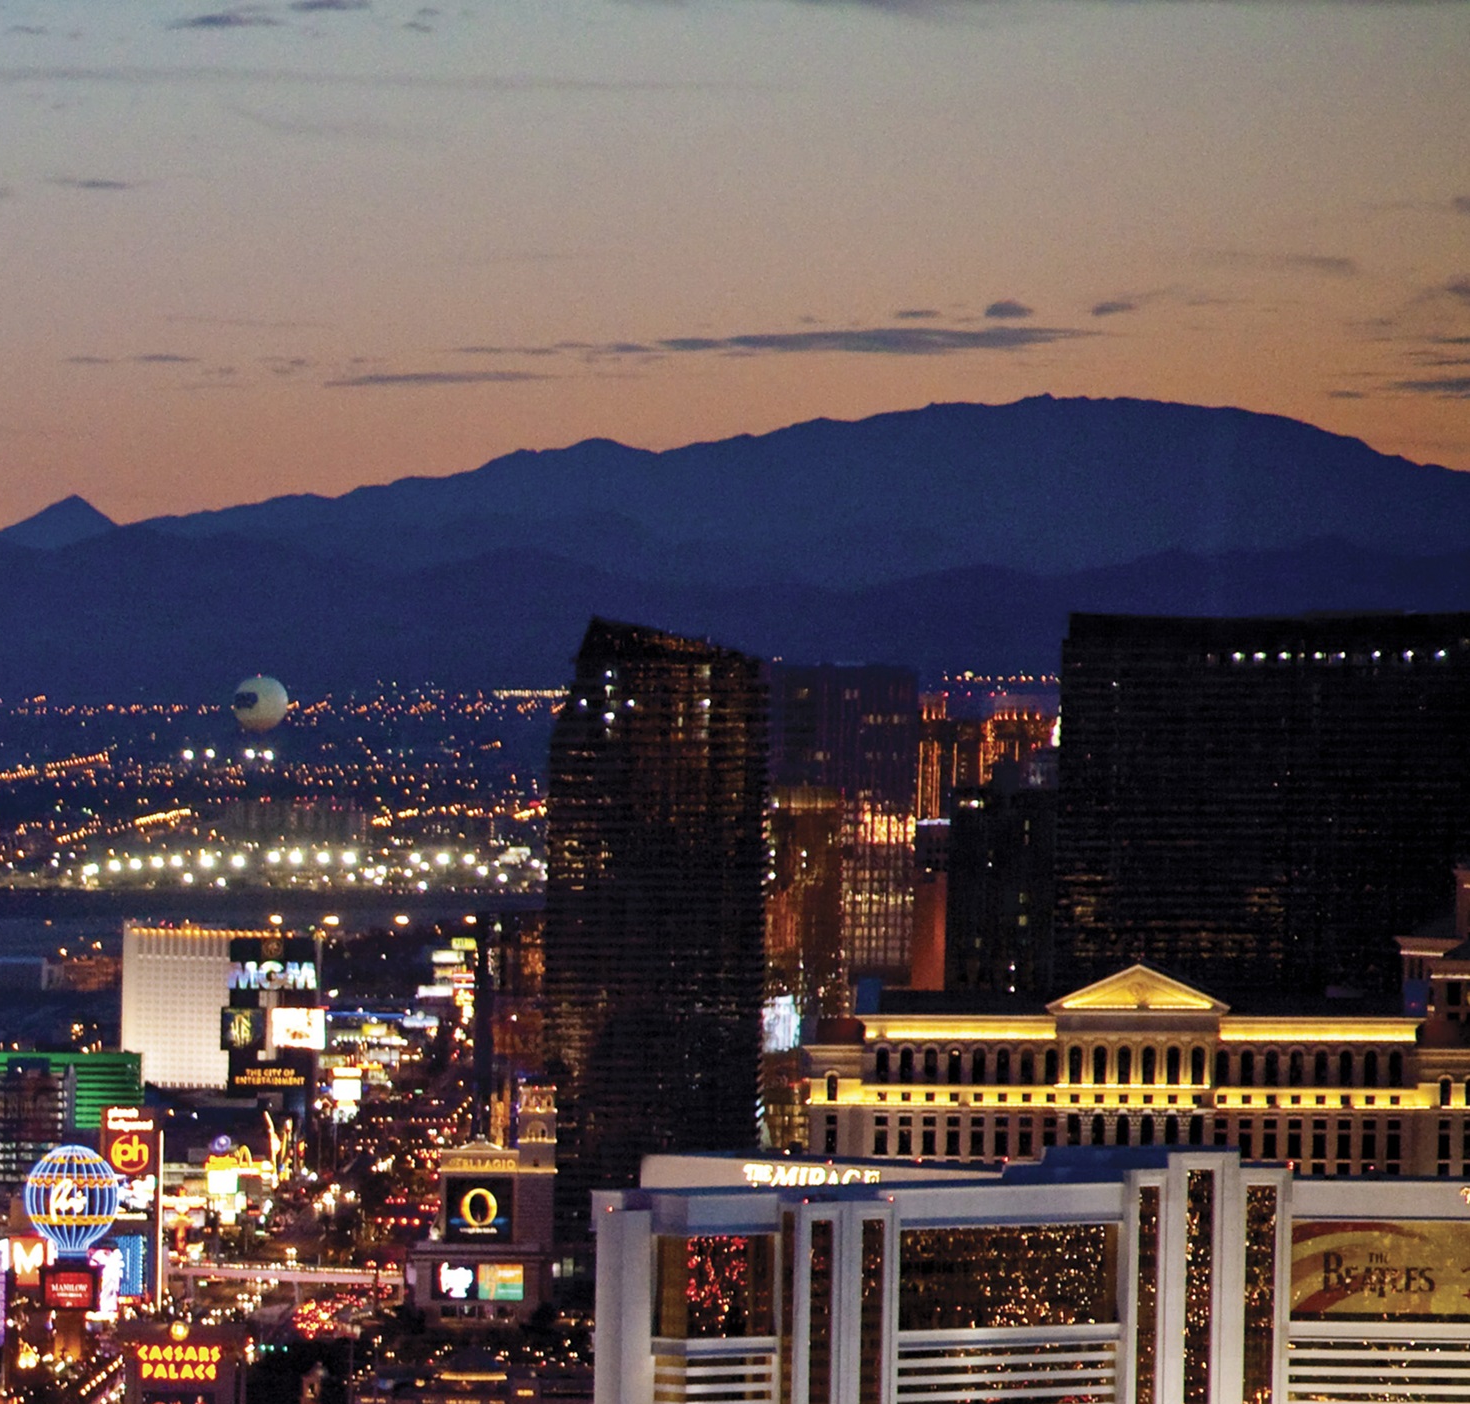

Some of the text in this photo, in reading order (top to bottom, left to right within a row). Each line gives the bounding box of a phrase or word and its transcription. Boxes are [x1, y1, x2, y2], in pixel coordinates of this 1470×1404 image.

[227, 961, 318, 990] MGM
[234, 1076, 306, 1086] ENTERTAINMENT
[460, 1187, 498, 1227] O
[1322, 1251, 1436, 1298] BEATLES
[137, 1344, 222, 1362] CAESARS
[141, 1363, 217, 1380] PALACE
